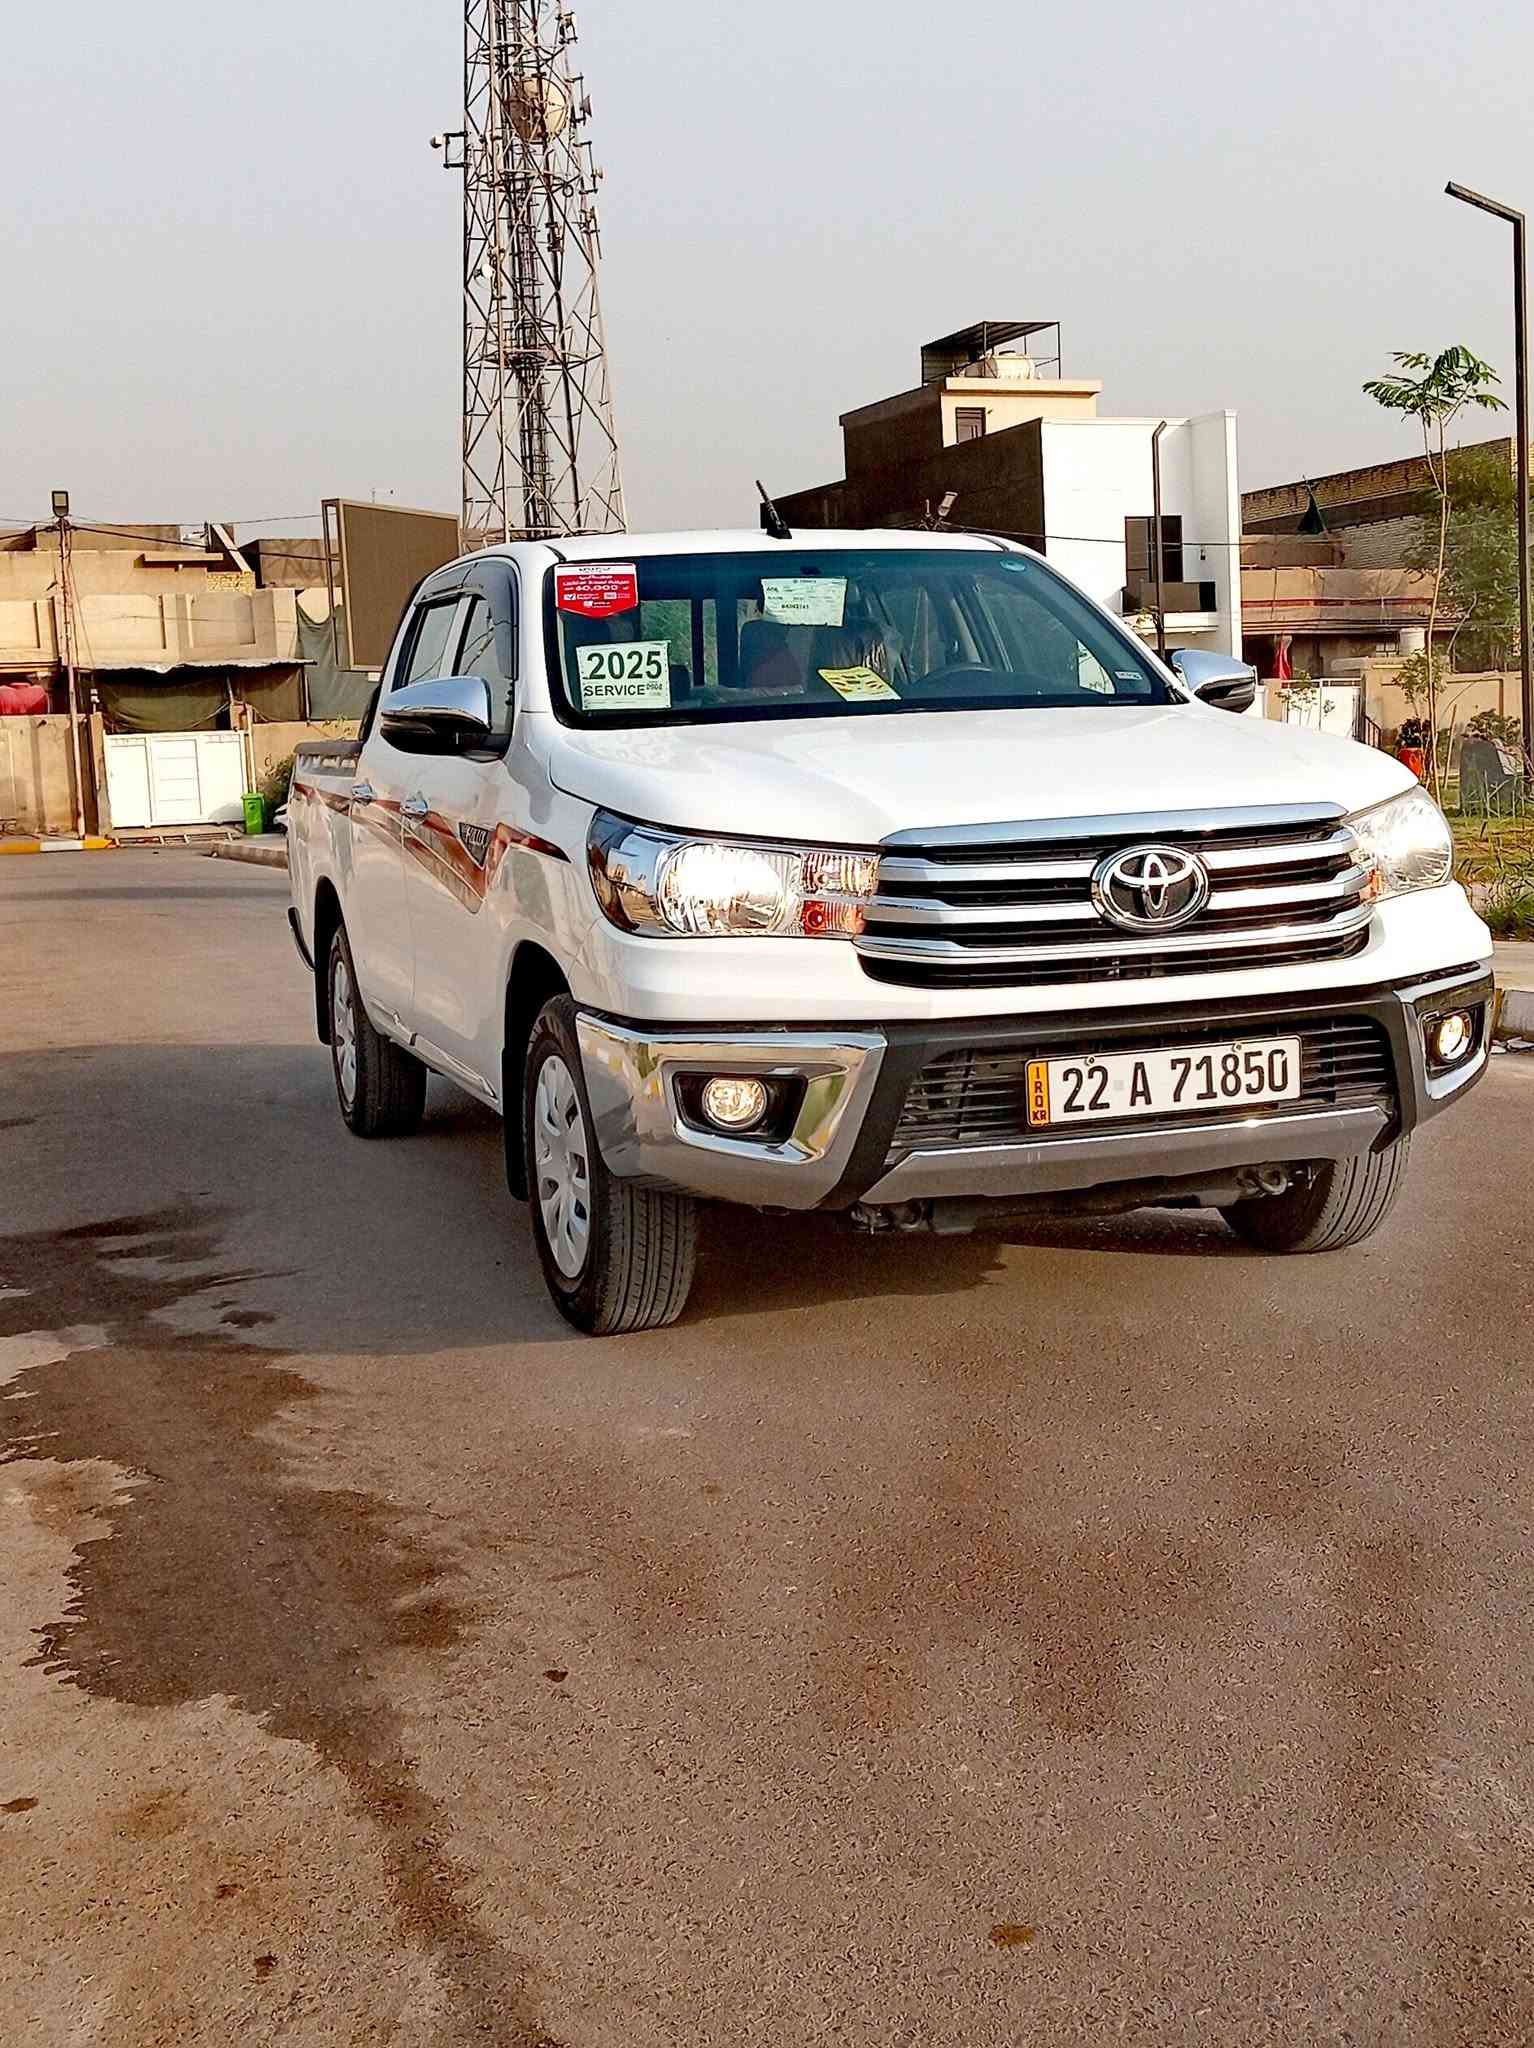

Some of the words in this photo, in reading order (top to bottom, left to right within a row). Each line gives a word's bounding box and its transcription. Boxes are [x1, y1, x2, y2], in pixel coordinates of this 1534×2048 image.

[586, 650, 662, 680] 2025
[583, 684, 646, 697] SERVICE
[1062, 1065, 1110, 1113] 22
[1129, 1061, 1152, 1107] A
[1170, 1048, 1289, 1103] 71850
[1032, 1110, 1047, 1121] KR
